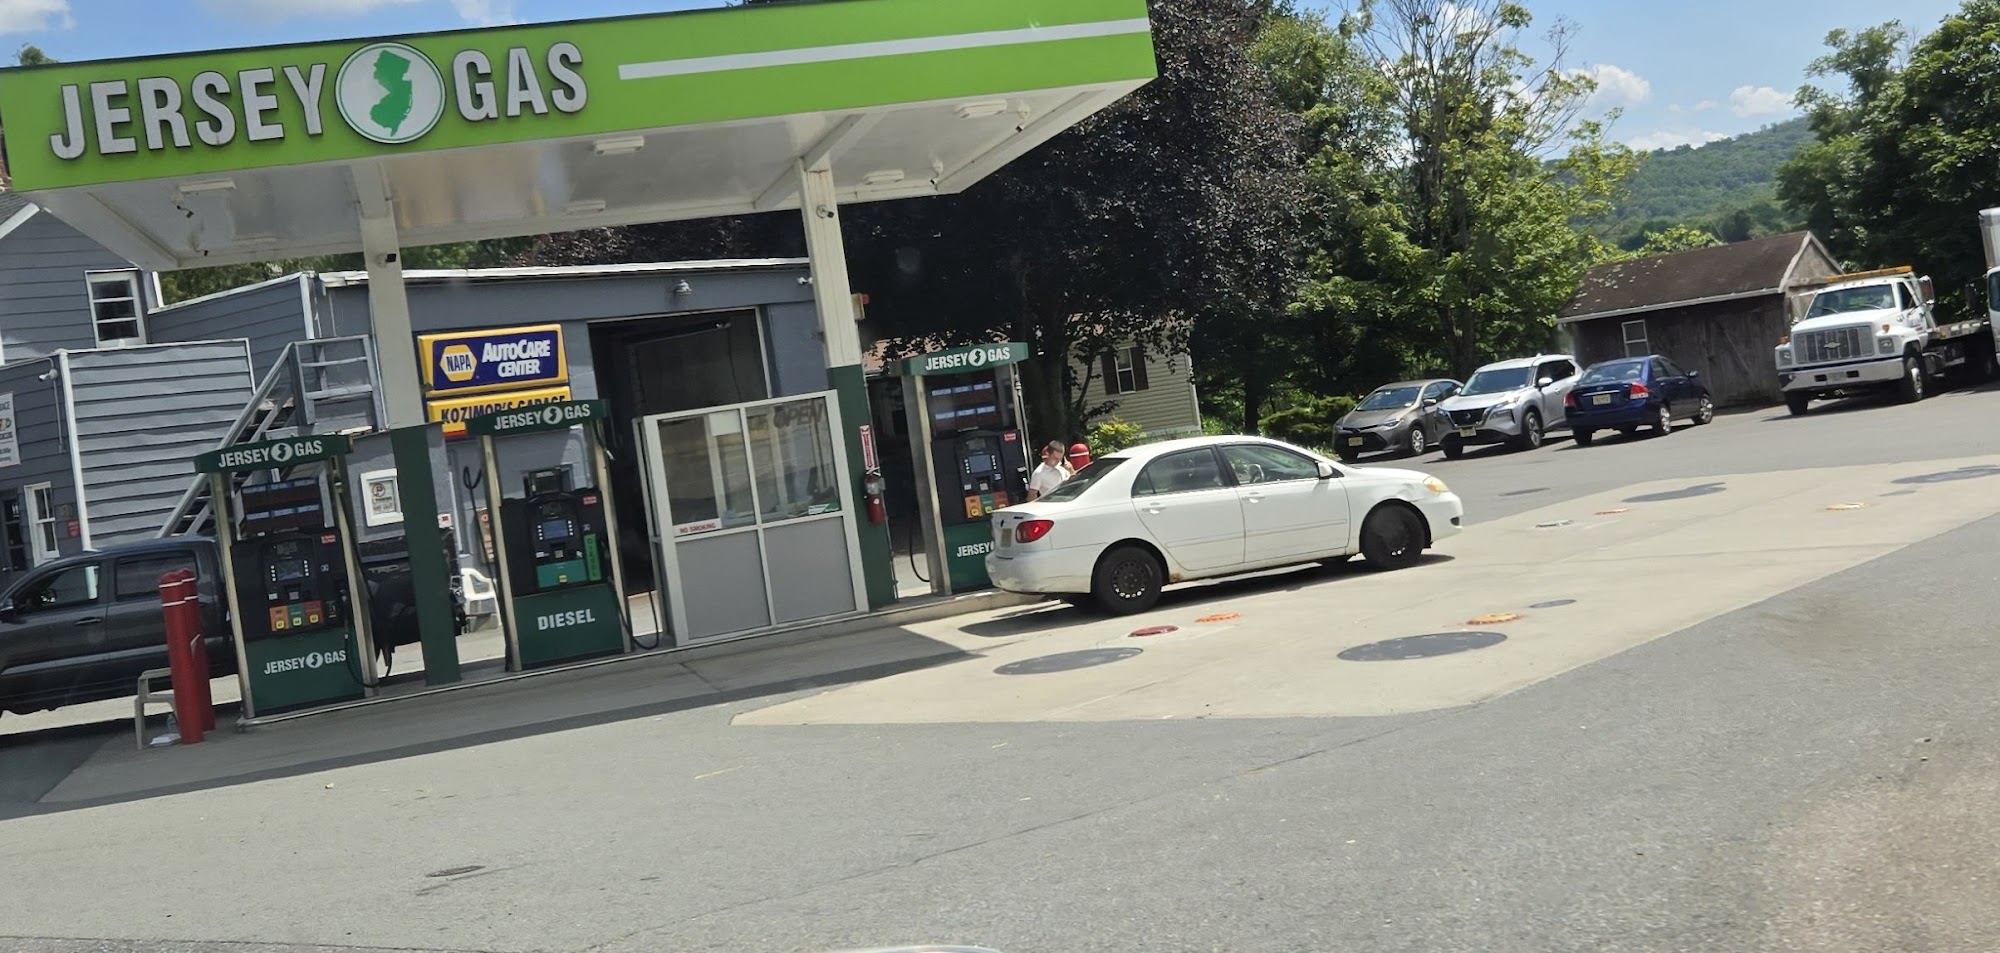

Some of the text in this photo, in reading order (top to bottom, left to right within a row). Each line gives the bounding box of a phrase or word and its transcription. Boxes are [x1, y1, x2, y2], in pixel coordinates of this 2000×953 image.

[50, 42, 588, 160] JERSEY GAS
[446, 354, 472, 373] NAPA
[498, 359, 540, 378] CENTER
[925, 347, 1010, 371] JERSEY GAS
[494, 404, 591, 431] JERSEY GAS
[774, 403, 824, 428] OPEN
[218, 440, 323, 468] JERSEY GAS
[690, 522, 716, 532] SMOKING
[957, 541, 991, 558] JERSEY
[538, 608, 595, 631] DIESEL
[264, 650, 346, 675] JERSEY GAS
